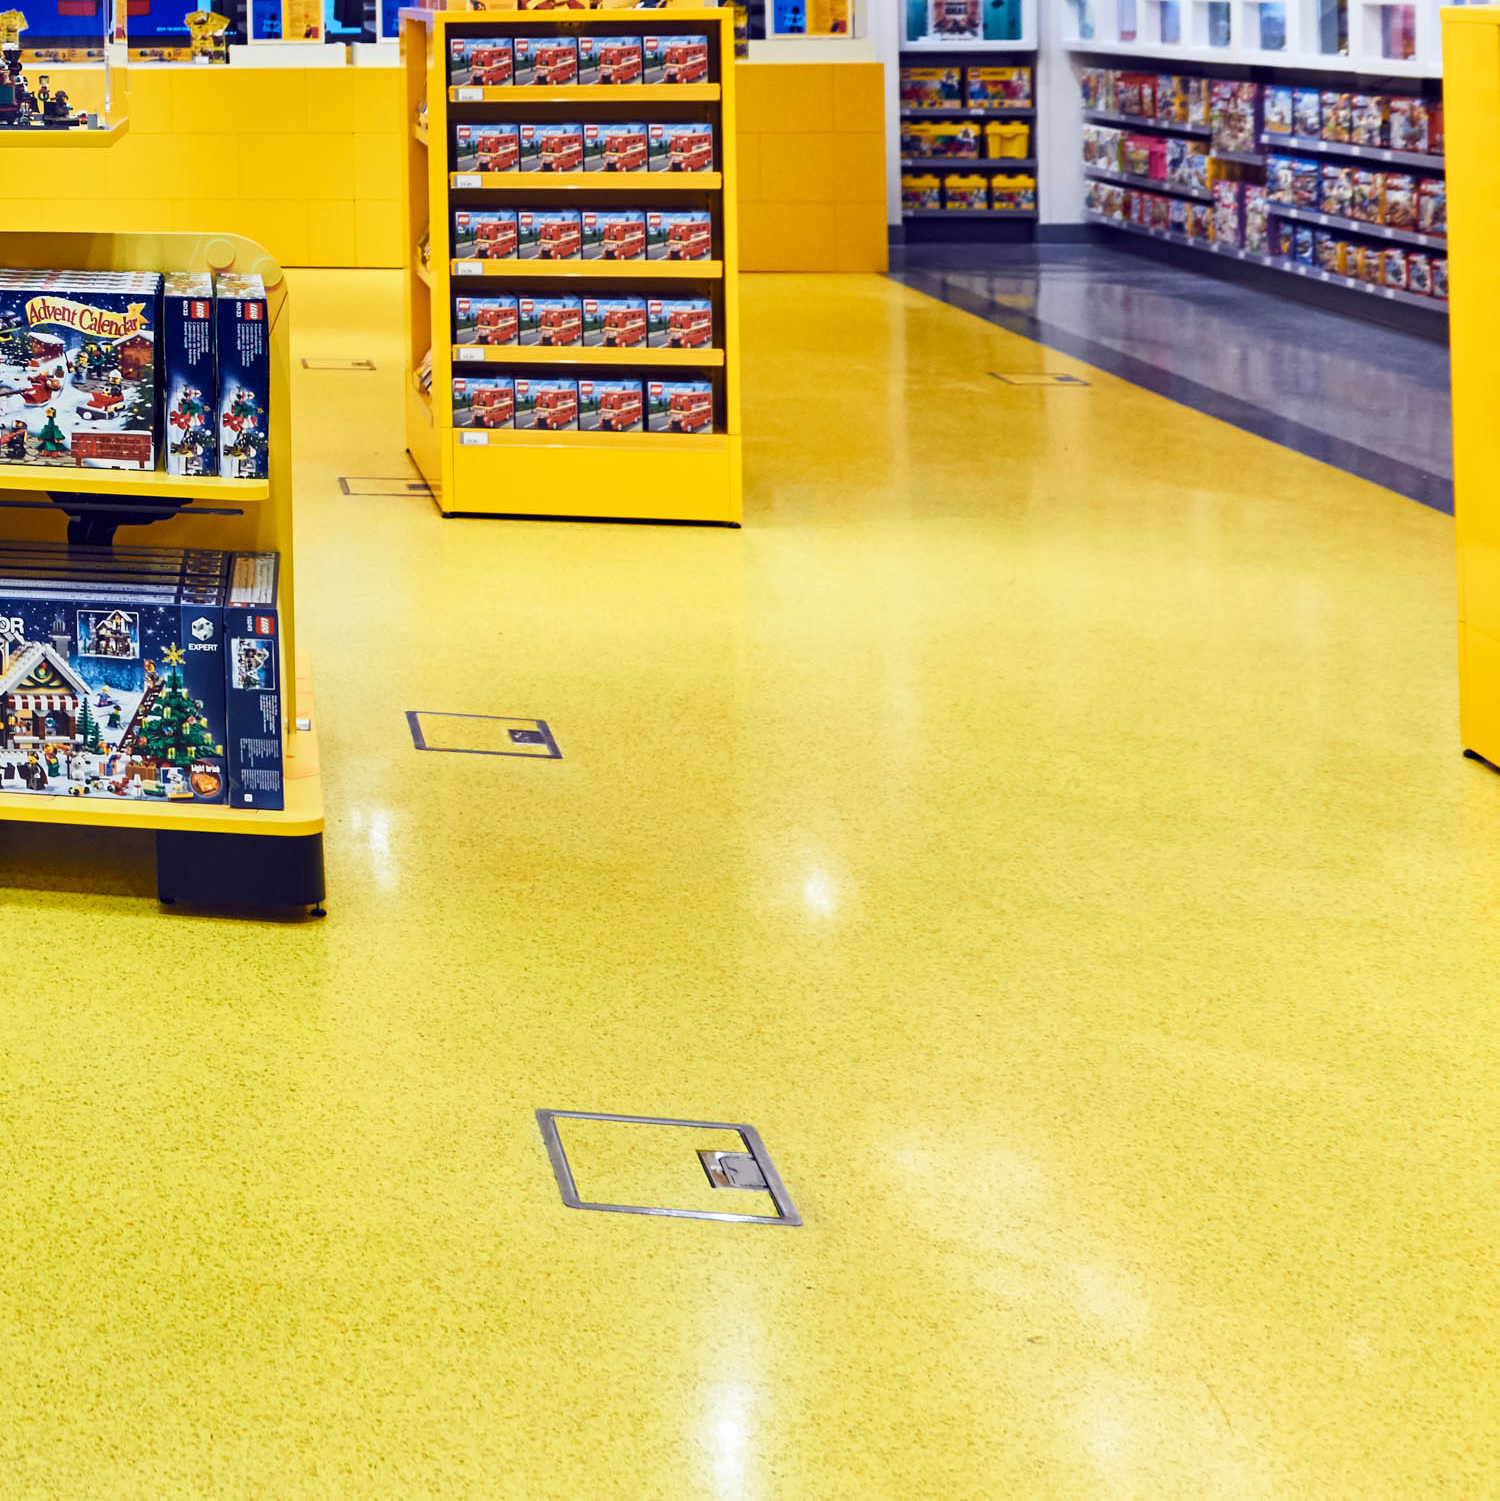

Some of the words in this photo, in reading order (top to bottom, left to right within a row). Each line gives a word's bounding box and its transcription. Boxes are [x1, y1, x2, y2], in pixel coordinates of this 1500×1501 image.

[28, 302, 78, 327] Advent
[79, 307, 138, 336] Calendar
[188, 643, 218, 651] EXPERT
[191, 764, 205, 773] Light
[206, 764, 220, 773] brick
